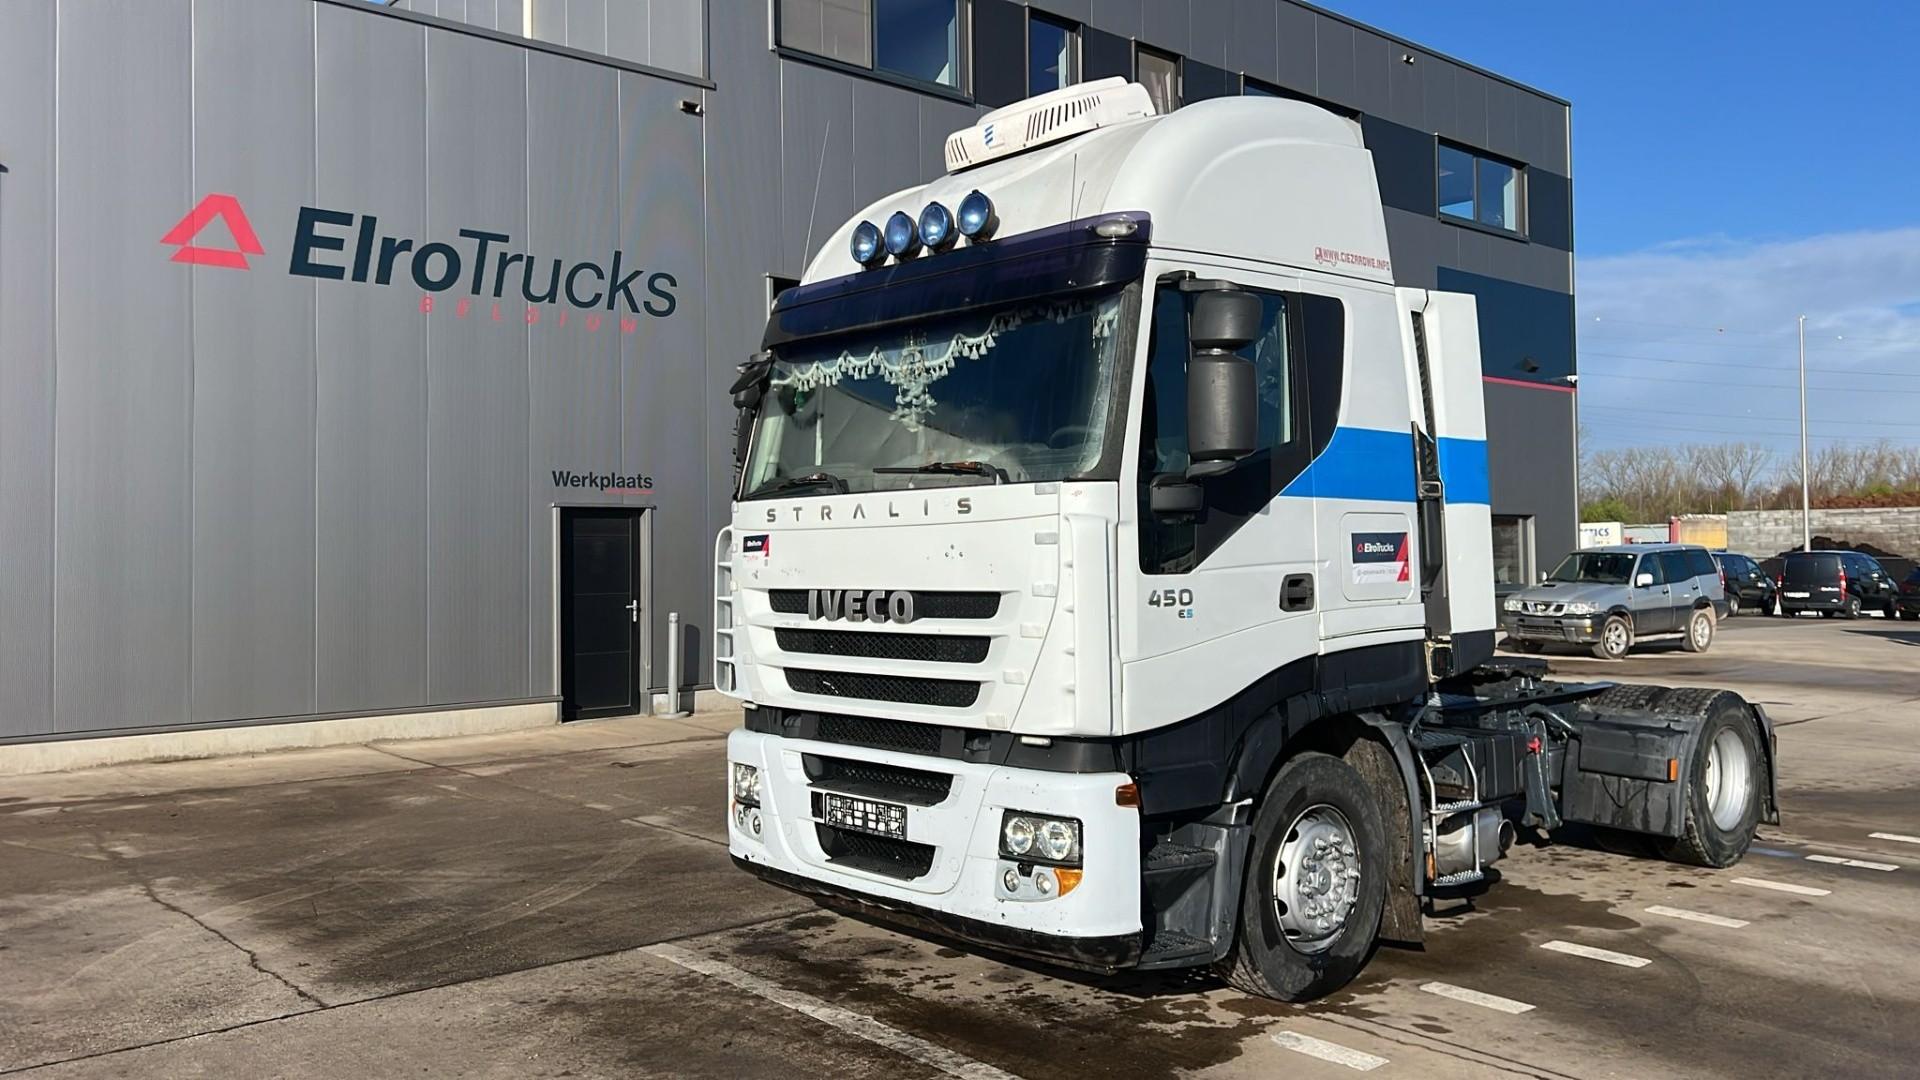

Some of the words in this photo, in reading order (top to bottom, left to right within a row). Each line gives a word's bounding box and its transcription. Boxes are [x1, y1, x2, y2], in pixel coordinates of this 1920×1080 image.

[289, 205, 678, 318] ElroTrucks
[552, 470, 653, 491] Werkplaats
[766, 497, 972, 523] STRALIS
[807, 589, 914, 625] IVECO
[1148, 588, 1194, 607] 450
